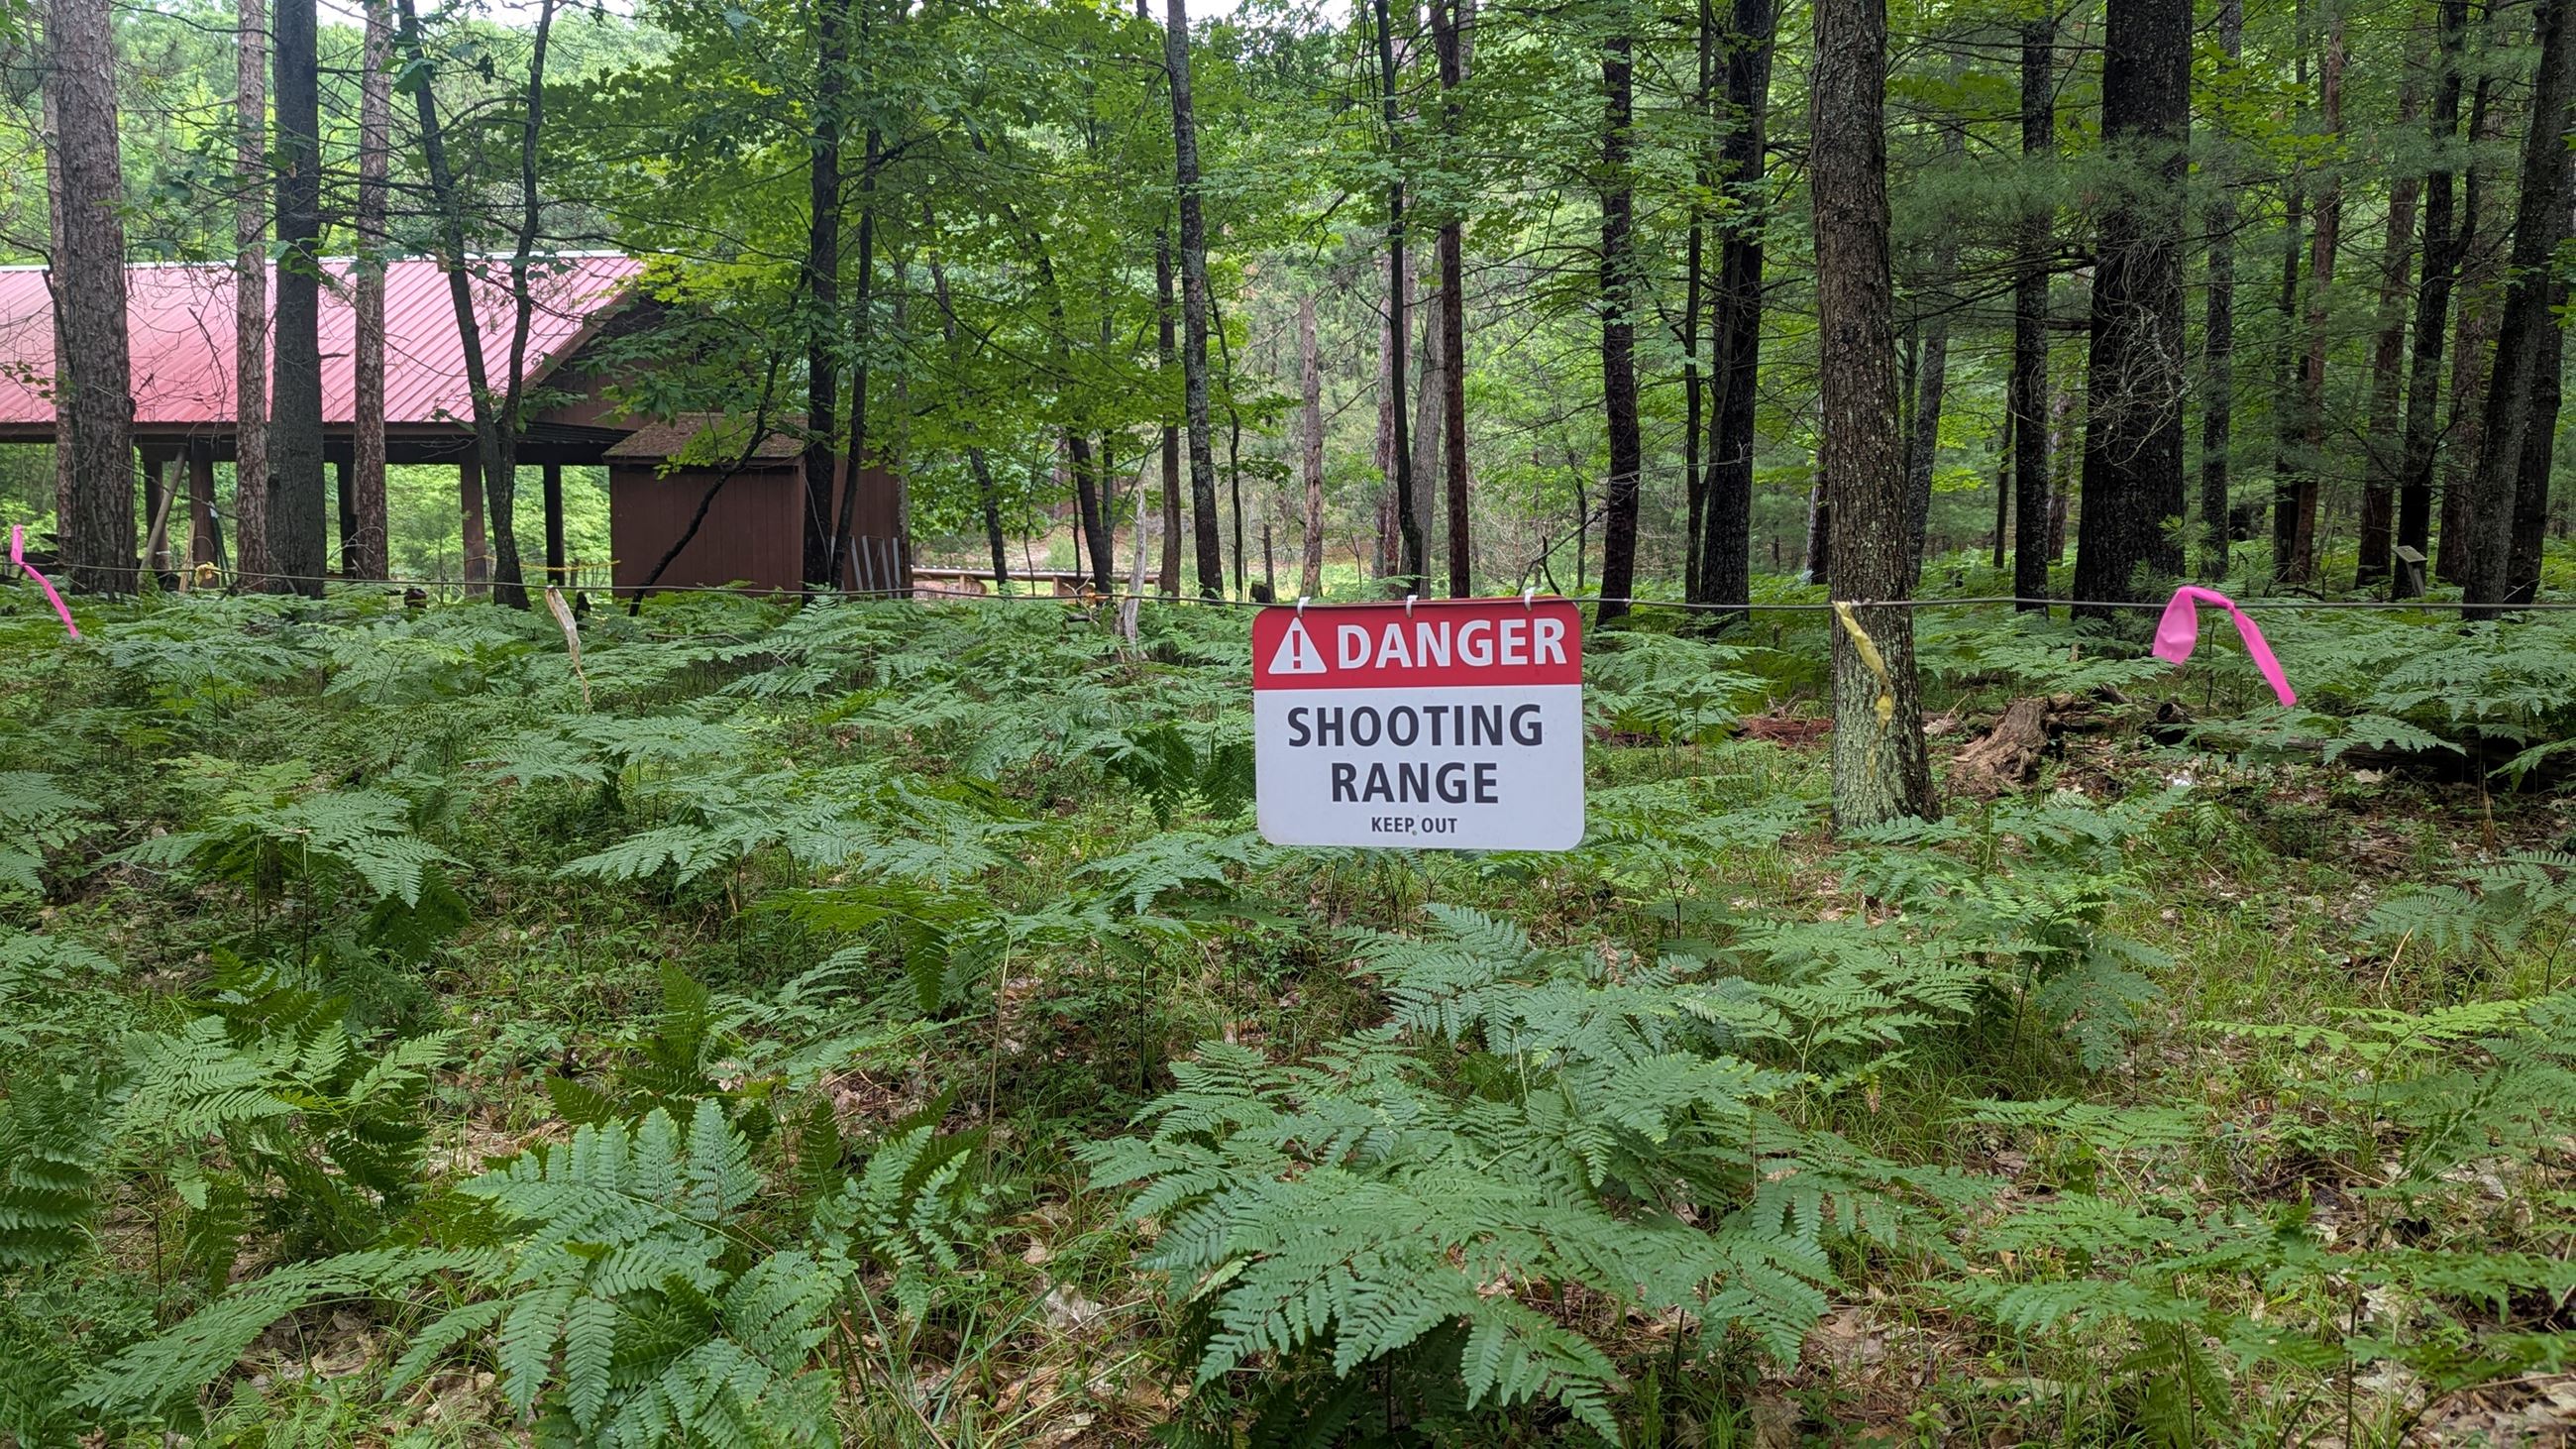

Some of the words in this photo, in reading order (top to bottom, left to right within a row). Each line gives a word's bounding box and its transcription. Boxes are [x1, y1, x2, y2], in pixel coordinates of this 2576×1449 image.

[1338, 617, 1567, 669] DANGER
[1287, 704, 1543, 747] SHOOTING
[1331, 761, 1499, 804] RANGE
[1371, 817, 1415, 833] KEEP
[1421, 817, 1457, 834] OUT
